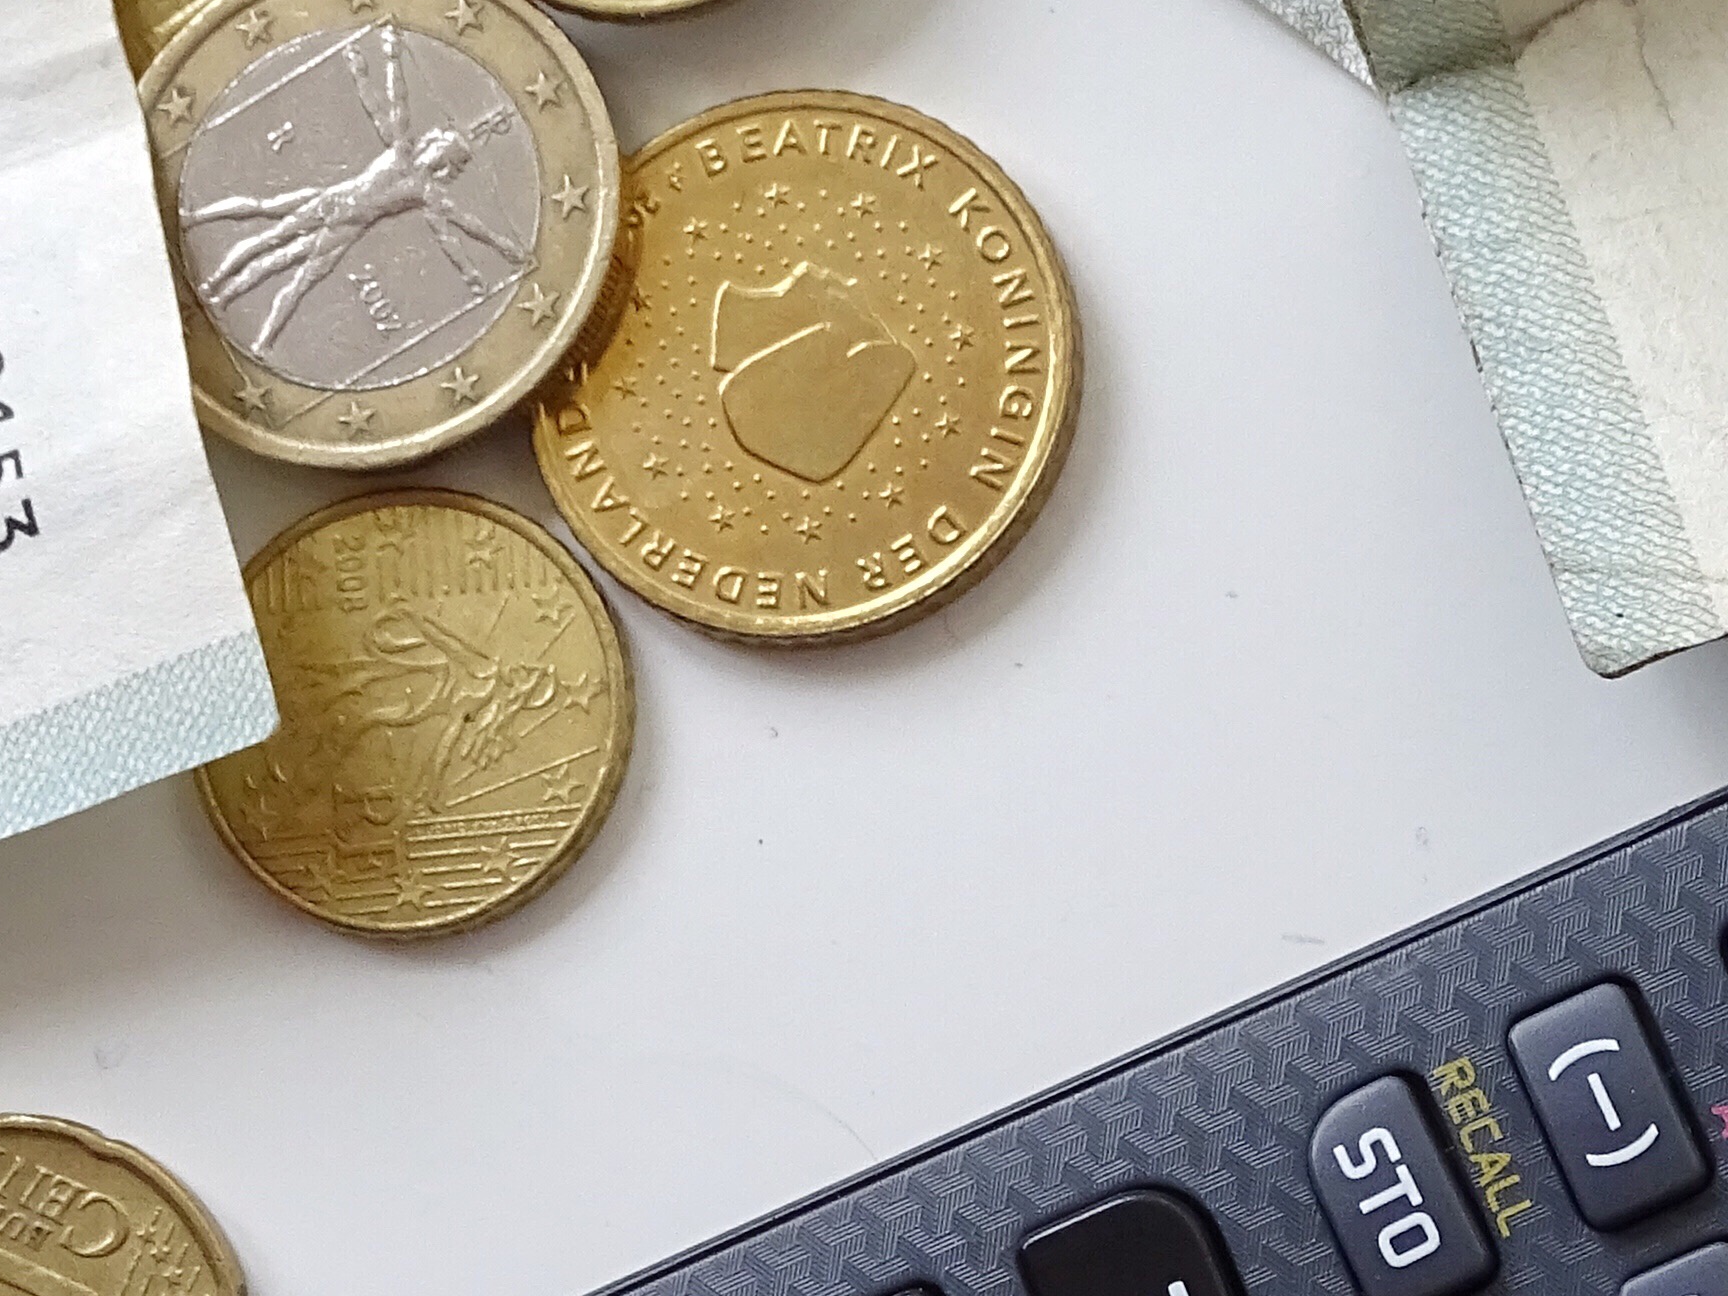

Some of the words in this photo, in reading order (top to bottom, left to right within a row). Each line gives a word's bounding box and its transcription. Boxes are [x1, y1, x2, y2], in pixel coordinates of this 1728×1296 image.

[694, 119, 940, 190] BEATRIX
[948, 187, 1042, 491] KONINGIN
[552, 400, 832, 611] NEDERLAND
[856, 504, 967, 591] DER
[1333, 1126, 1441, 1270] STO
[1433, 1057, 1533, 1240] RECALL
